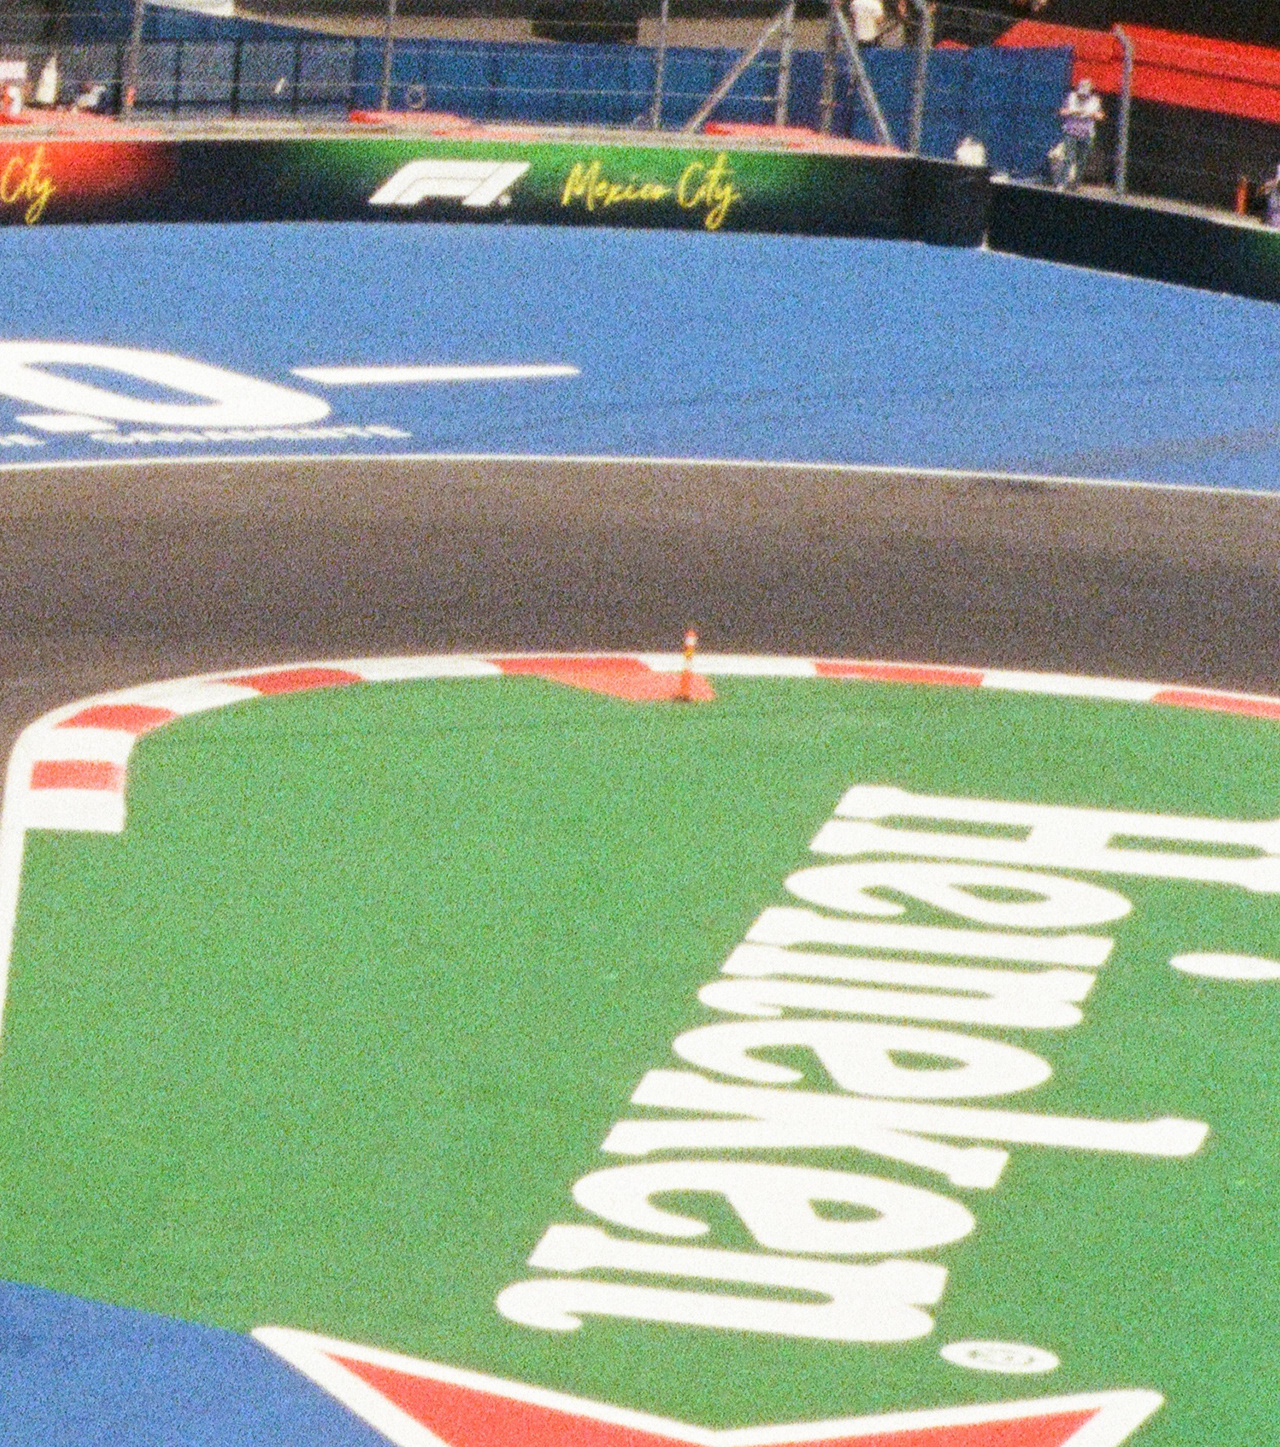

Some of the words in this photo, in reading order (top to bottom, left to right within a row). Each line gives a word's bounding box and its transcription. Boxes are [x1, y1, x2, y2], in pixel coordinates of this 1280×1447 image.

[0, 144, 57, 225] City
[561, 160, 670, 211] Mexico
[676, 152, 741, 231] City
[496, 783, 1280, 1344] Heineken
